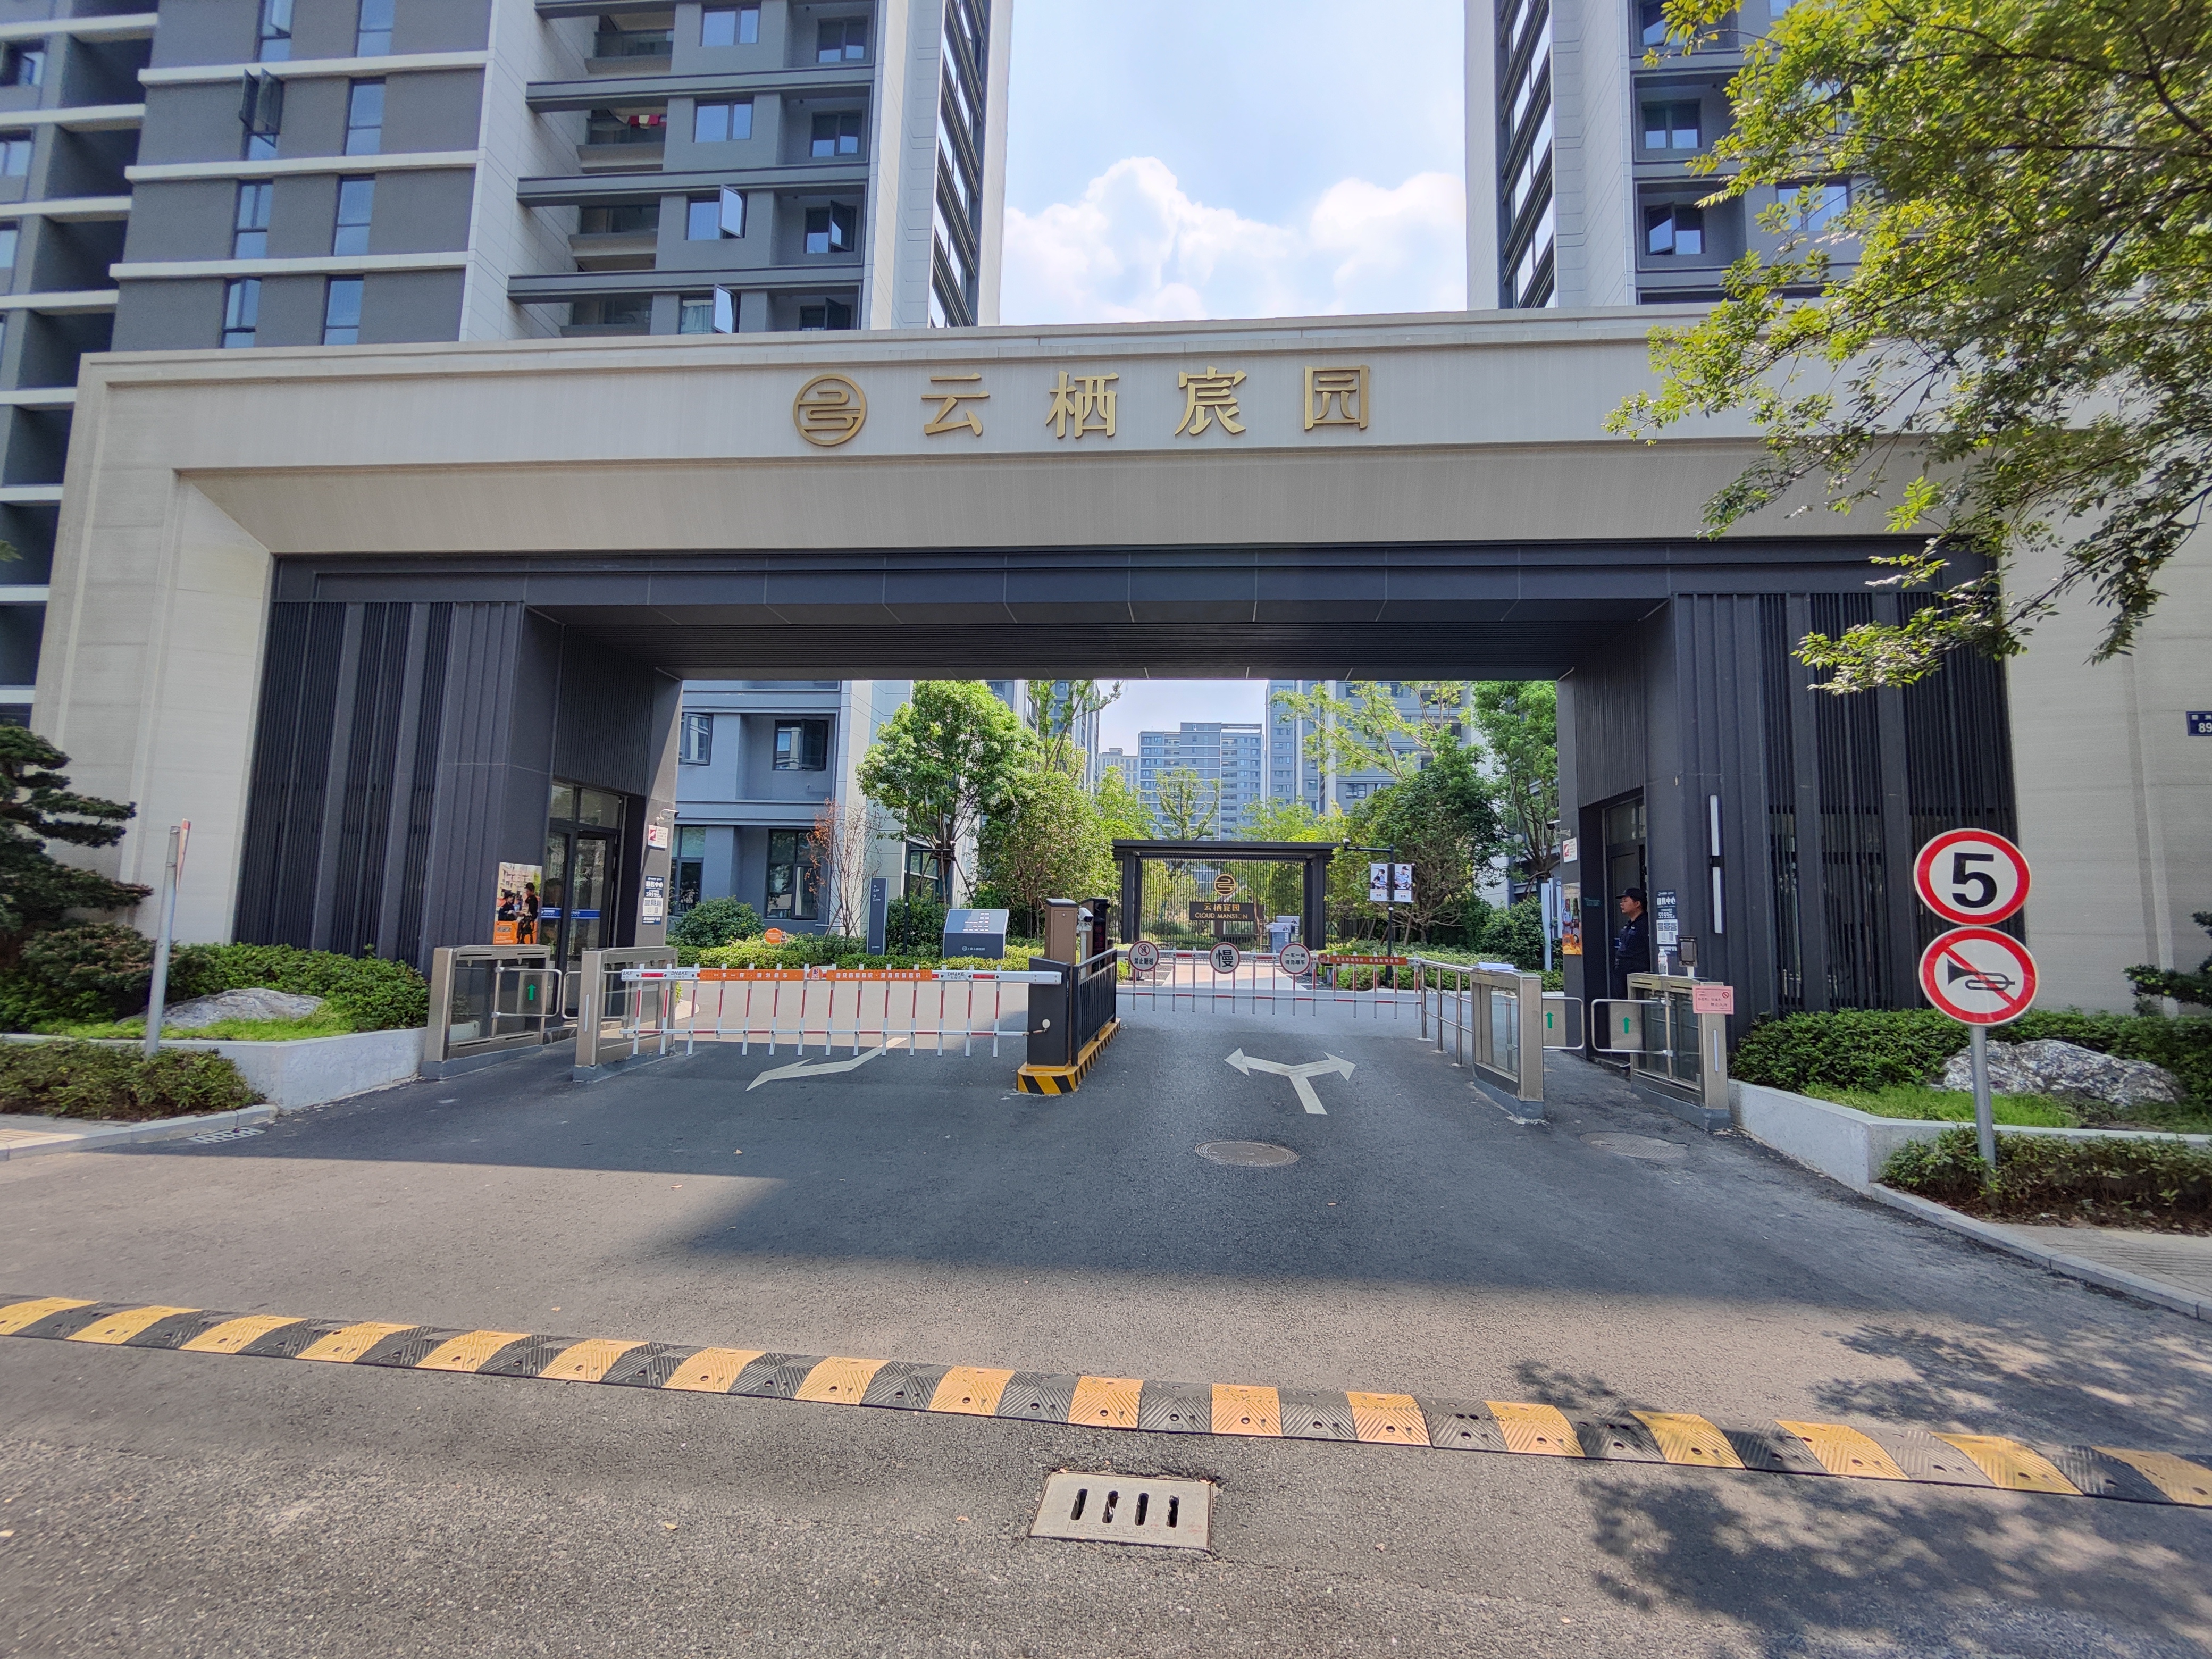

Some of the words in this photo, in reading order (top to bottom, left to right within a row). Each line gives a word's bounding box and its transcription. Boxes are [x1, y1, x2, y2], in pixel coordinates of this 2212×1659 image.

[921, 365, 1370, 438] 云栖宸园
[1952, 852, 1997, 908] 5
[1204, 903, 1240, 912] 云栖宸园
[1657, 896, 1676, 906] 中心
[1216, 949, 1234, 968] 慢
